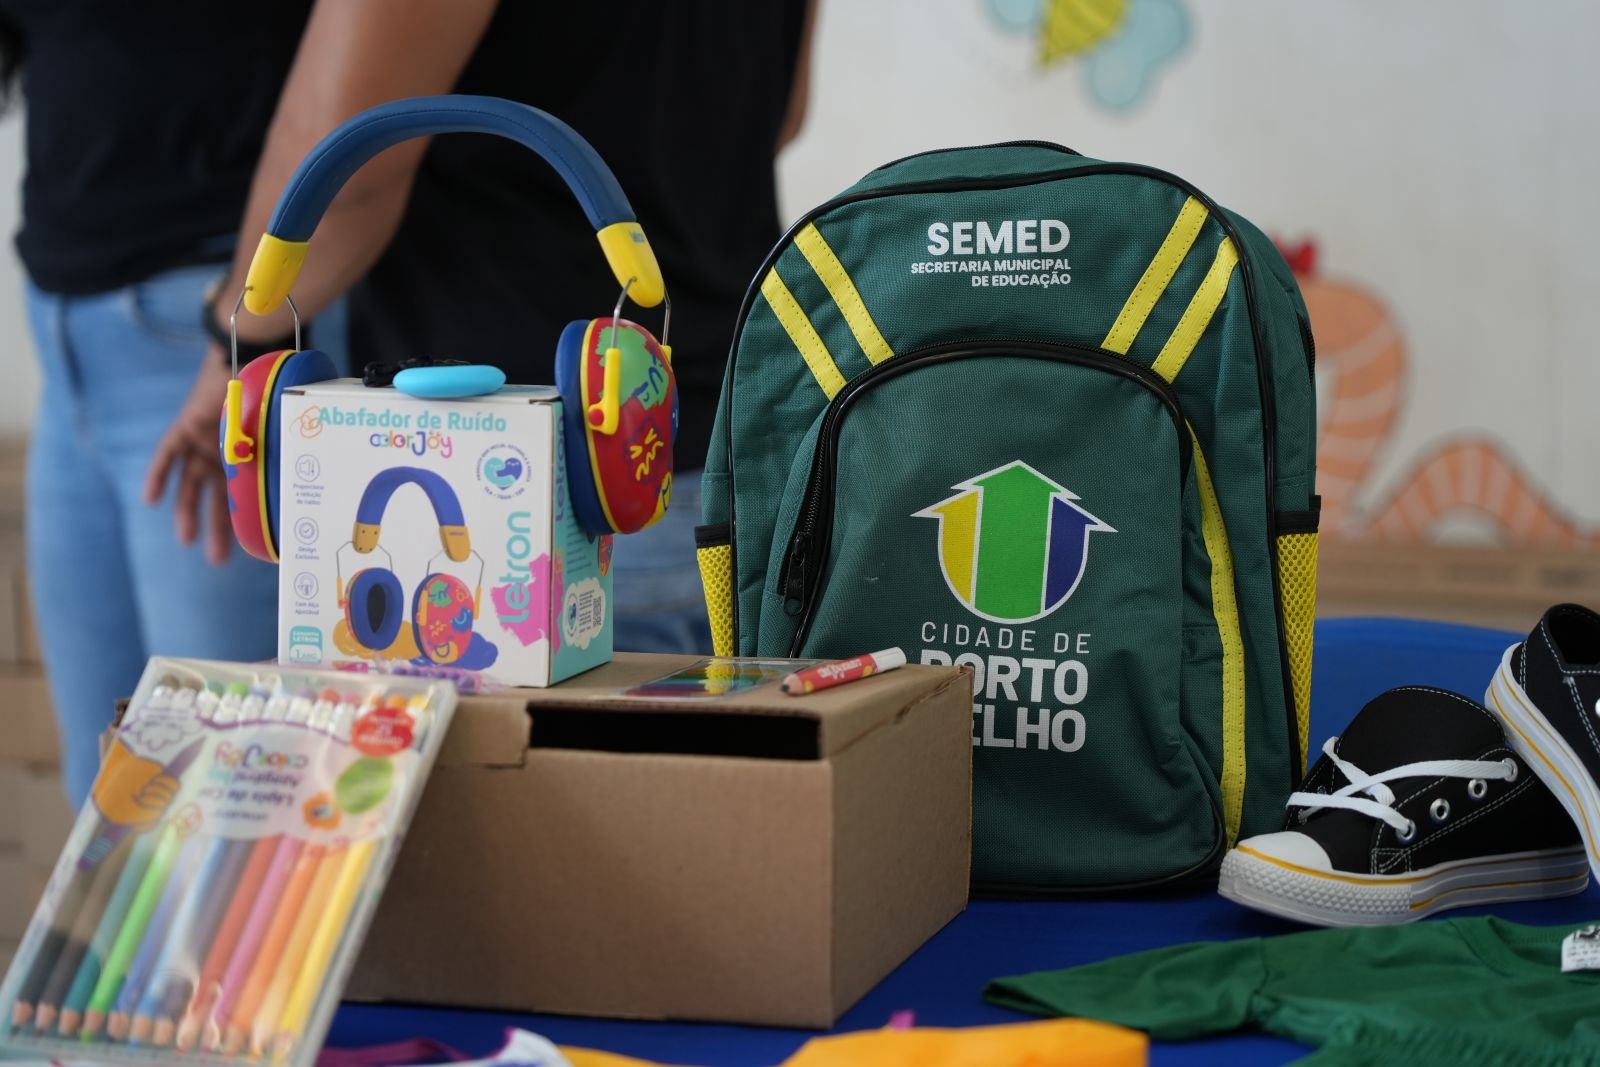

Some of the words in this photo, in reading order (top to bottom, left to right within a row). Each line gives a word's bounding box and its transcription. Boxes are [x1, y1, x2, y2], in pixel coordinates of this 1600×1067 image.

[927, 219, 1071, 256] SEMED
[910, 260, 991, 274] SECRETARIA
[994, 258, 1071, 272] MUNICIPAL
[971, 275, 989, 287] DE
[991, 272, 1071, 288] EDUCAÇÃO
[317, 406, 411, 428] Abafador
[417, 411, 442, 430] de
[447, 411, 507, 432] Ruído
[921, 621, 1036, 651] CIDADE
[1054, 632, 1091, 654] DE
